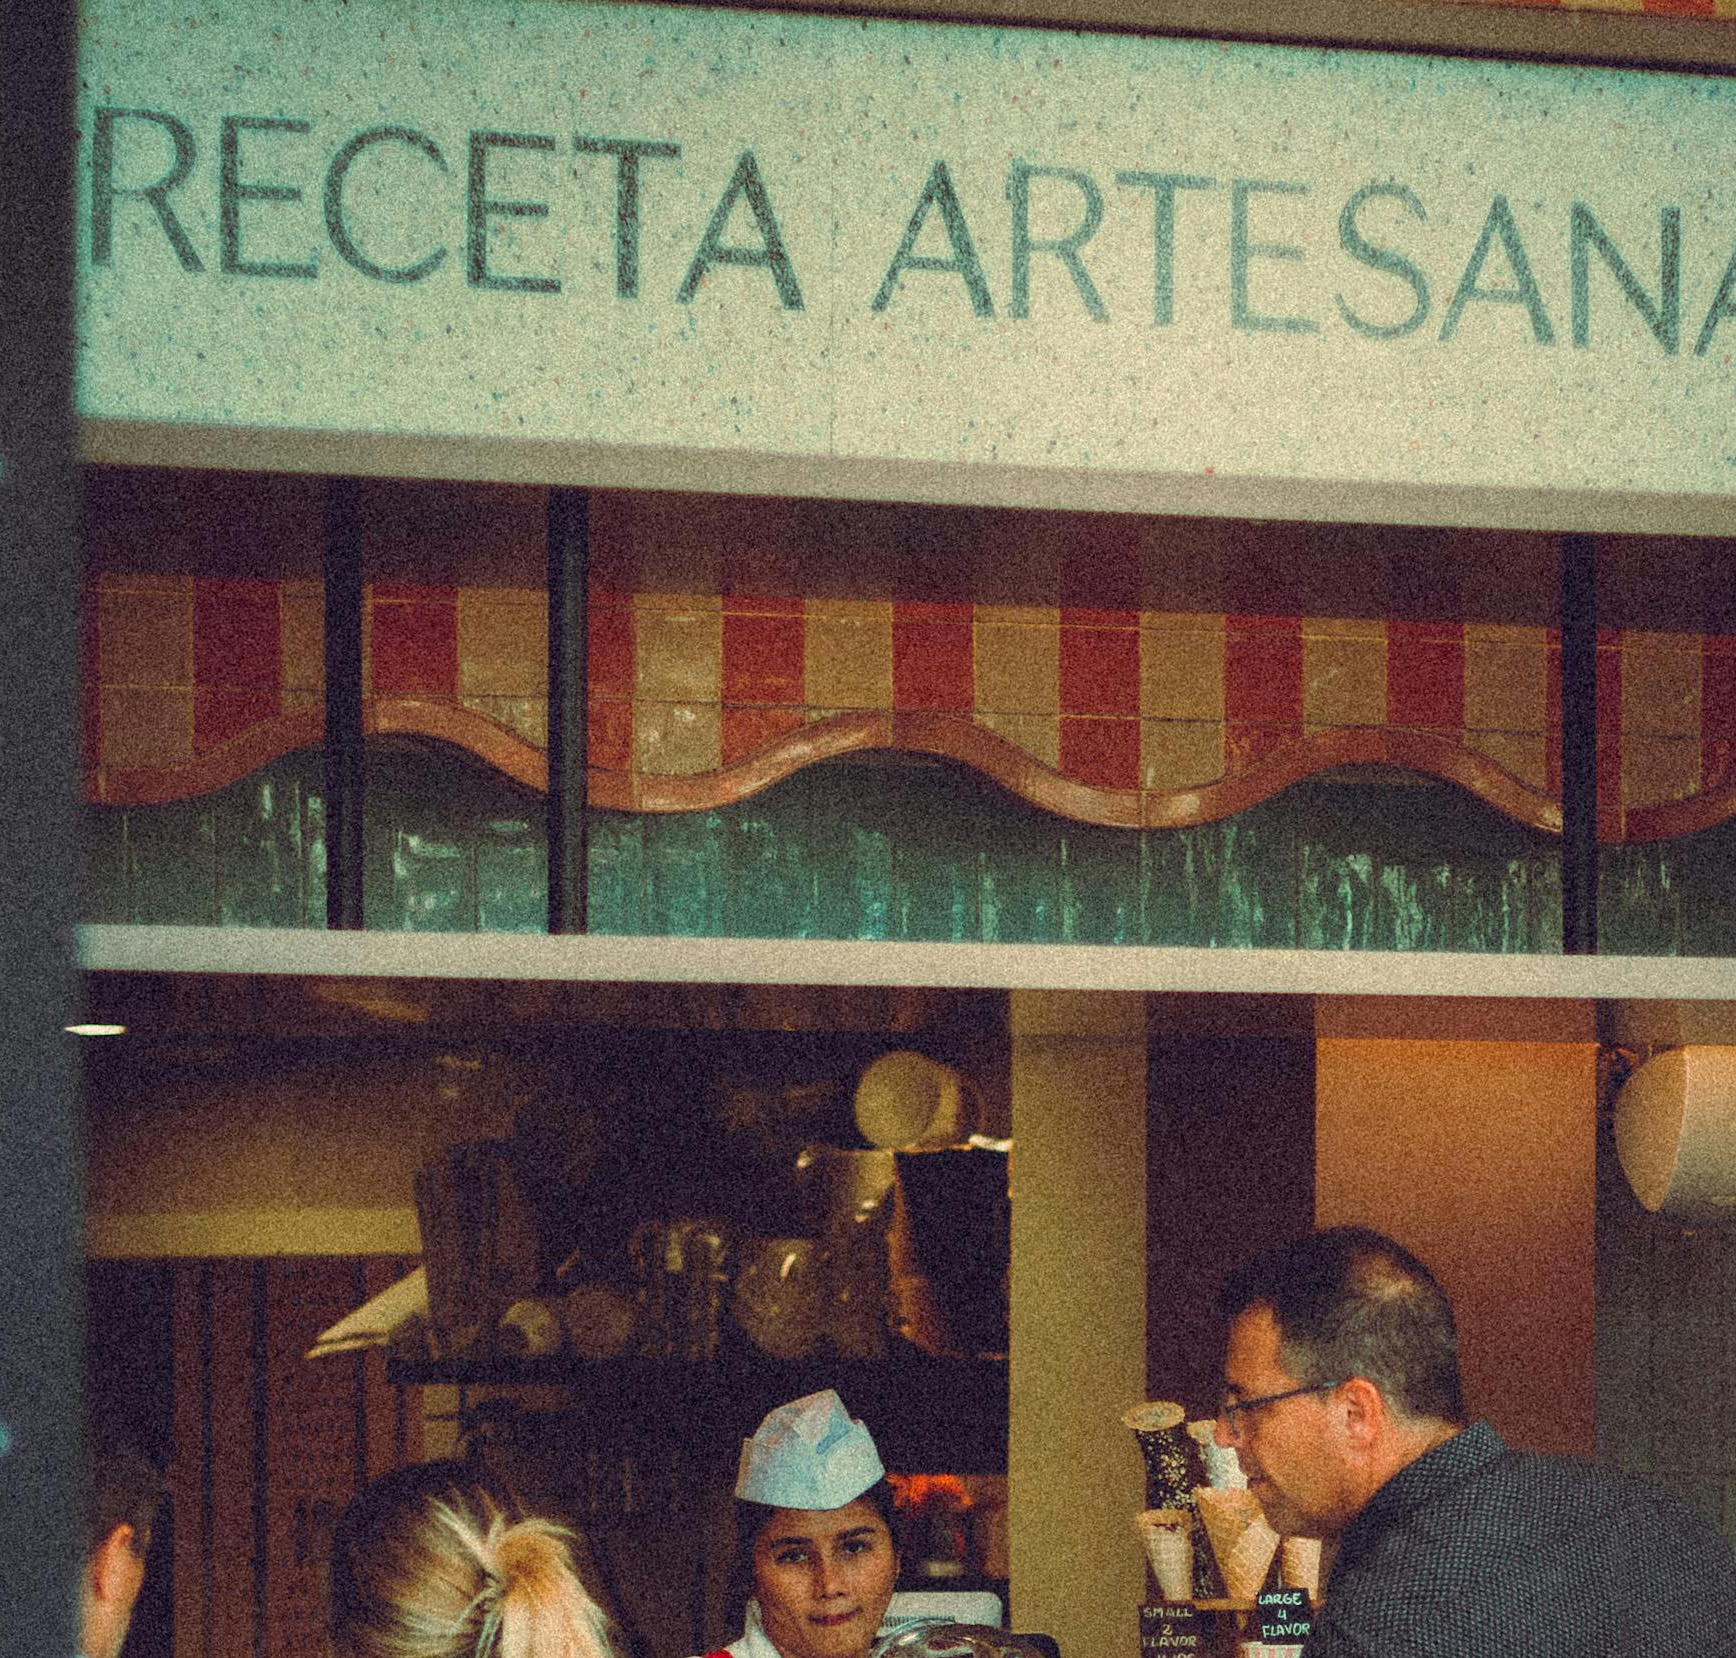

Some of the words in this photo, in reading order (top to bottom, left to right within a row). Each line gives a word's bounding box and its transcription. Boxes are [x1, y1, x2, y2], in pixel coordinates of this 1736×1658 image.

[91, 106, 806, 313] RECETA
[1258, 1592, 1302, 1606] LARGE
[1143, 1606, 1194, 1618] SMALL
[1276, 1609, 1287, 1620] 4
[1161, 1623, 1173, 1636] 2
[1261, 1621, 1311, 1639] FLAVOR
